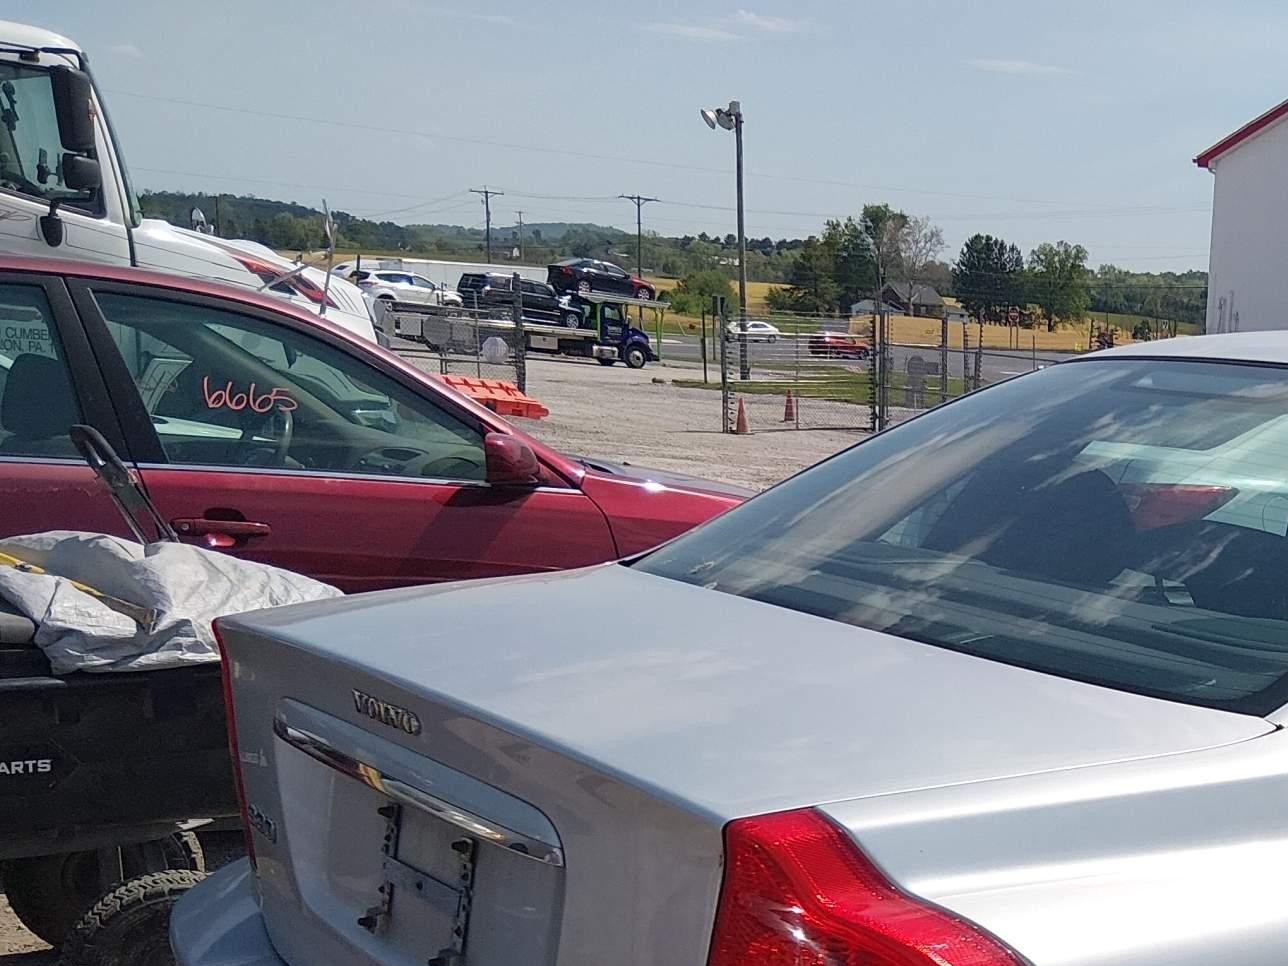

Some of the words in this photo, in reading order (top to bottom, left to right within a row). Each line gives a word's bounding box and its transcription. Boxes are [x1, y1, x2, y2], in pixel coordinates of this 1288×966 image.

[5, 326, 49, 340] CUMBE
[203, 376, 298, 413] 6665
[351, 688, 421, 735] VOLVO
[0, 759, 52, 775] ARTS
